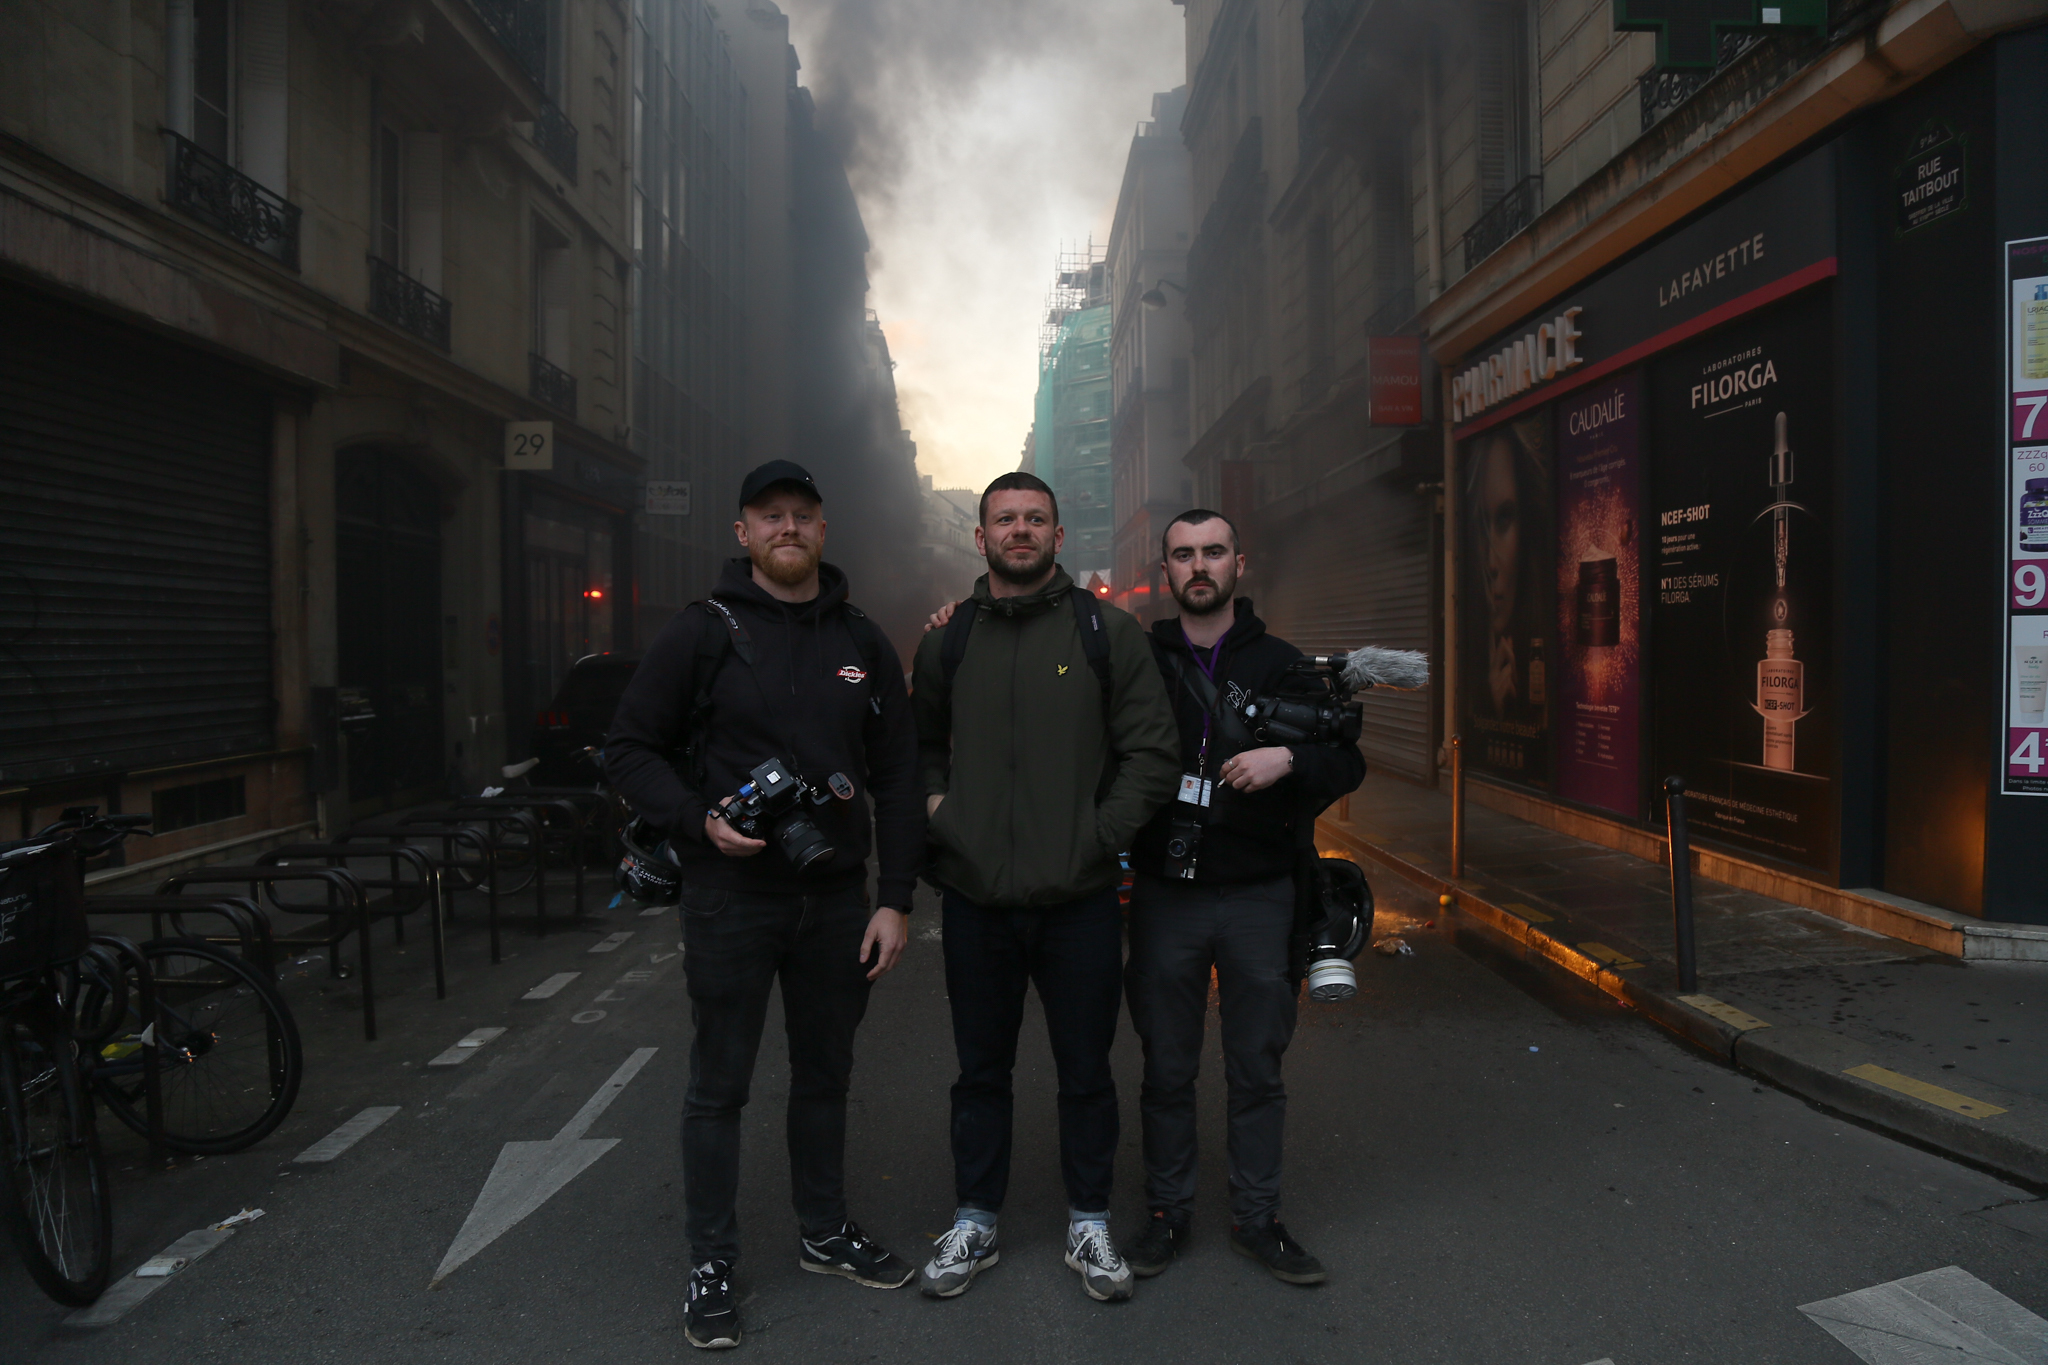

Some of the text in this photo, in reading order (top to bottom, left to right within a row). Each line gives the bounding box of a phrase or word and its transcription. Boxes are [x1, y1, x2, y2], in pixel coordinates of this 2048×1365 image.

[1918, 156, 1941, 181] RUE
[1902, 168, 1960, 208] TAITBOUT
[1659, 232, 1765, 308] LAFAYETTE
[1453, 306, 1584, 422] PHARMACIE
[1702, 346, 1762, 375] LABORATOIRES
[1372, 375, 1418, 386] MAMOU
[1691, 359, 1778, 410] FILORGA
[1744, 397, 1762, 408] PARIS
[2015, 395, 2048, 438] 7
[513, 433, 545, 456] 29
[2028, 462, 2045, 472] 60
[1661, 504, 1710, 526] NCEF-SHOT
[1673, 576, 1687, 589] DES
[1688, 572, 1719, 588] SÉRUMS
[2013, 564, 2046, 607] 9
[838, 669, 865, 679] Dickies
[1761, 676, 1800, 690] FILORGA
[1765, 699, 1796, 711] NCEF-SHOT
[2010, 732, 2045, 773] 4
[1708, 794, 1731, 808] FRANÇAIS
[1731, 799, 1739, 809] DE
[1739, 801, 1765, 816] MÉDECINE
[1766, 807, 1798, 823] ESTHÉTIQUE
